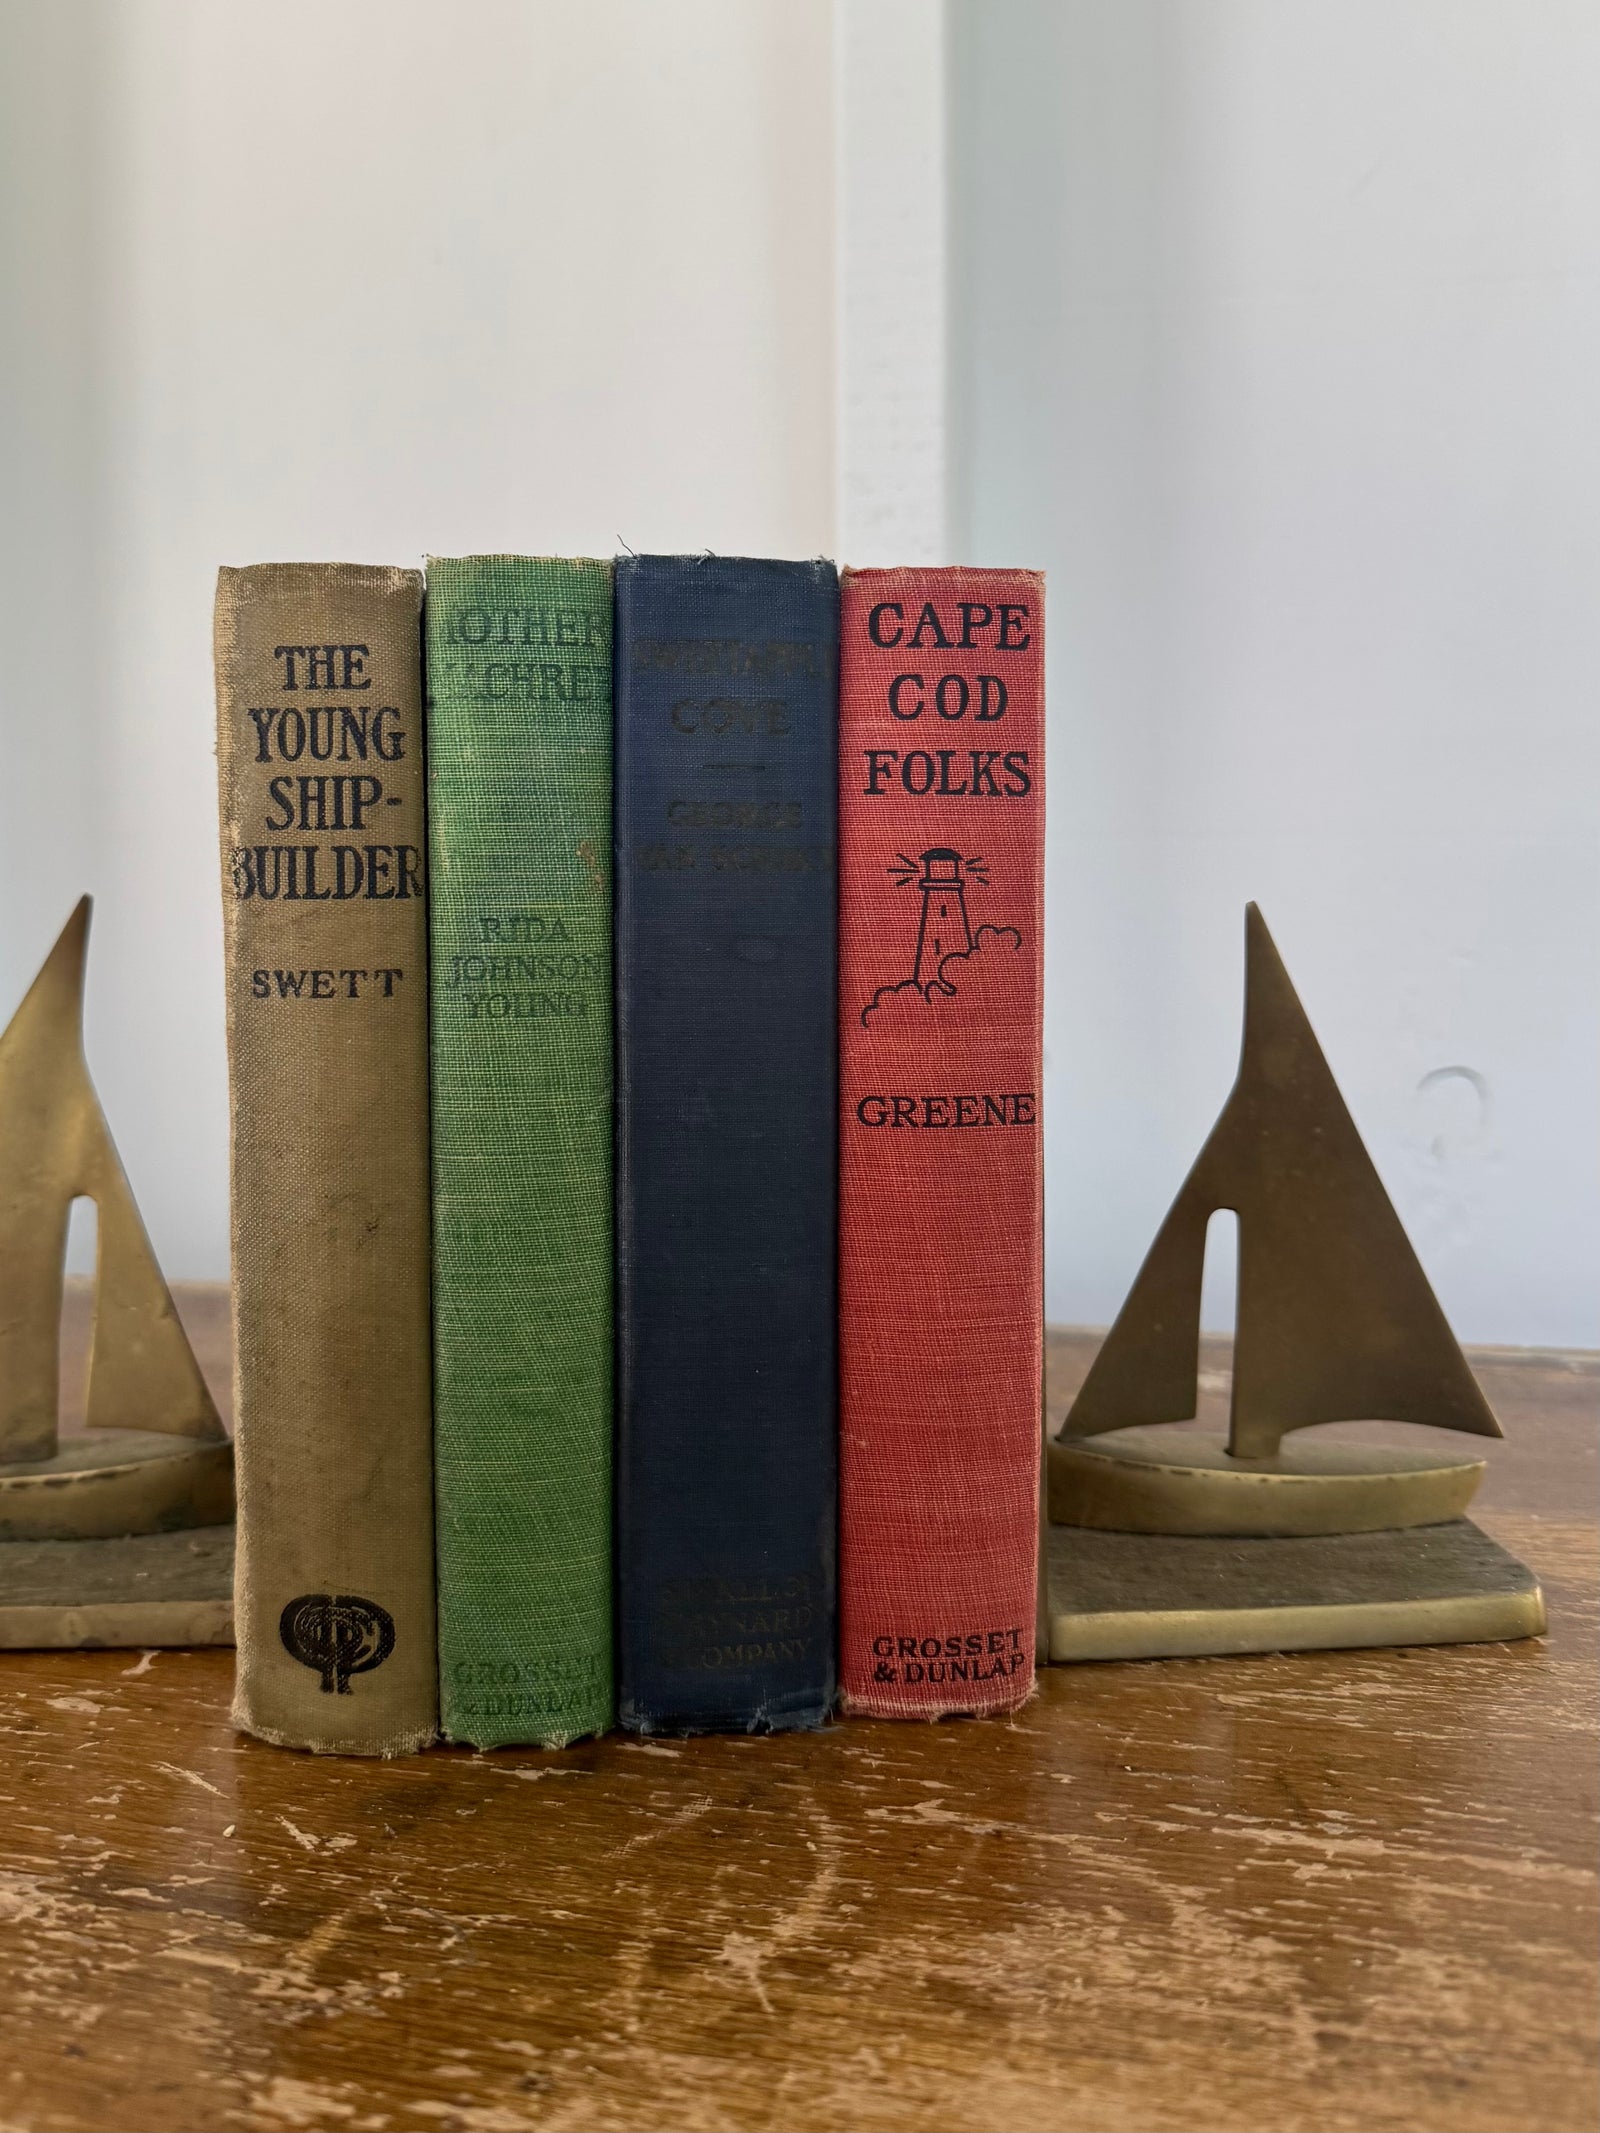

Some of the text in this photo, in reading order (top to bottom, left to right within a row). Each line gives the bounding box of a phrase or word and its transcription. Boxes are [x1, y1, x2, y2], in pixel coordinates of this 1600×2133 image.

[868, 602, 1031, 652] CAPE
[274, 644, 372, 691] THE
[671, 697, 791, 736] COVE
[888, 674, 1009, 722] COD
[248, 707, 406, 763] YOUNG
[863, 750, 1032, 798] FOLKS
[266, 775, 402, 831] SHIP-
[232, 845, 425, 901] BUILDER
[480, 916, 572, 944] RIDA
[252, 968, 404, 1000] SWETT
[446, 954, 602, 988] JOHNSON
[463, 991, 589, 1019] YOUNG
[857, 1093, 1037, 1128] GREENE
[689, 1637, 812, 1670] OMPANY
[872, 1628, 1023, 1658] GROSSET
[873, 1653, 1026, 1684] & DUNLAP
